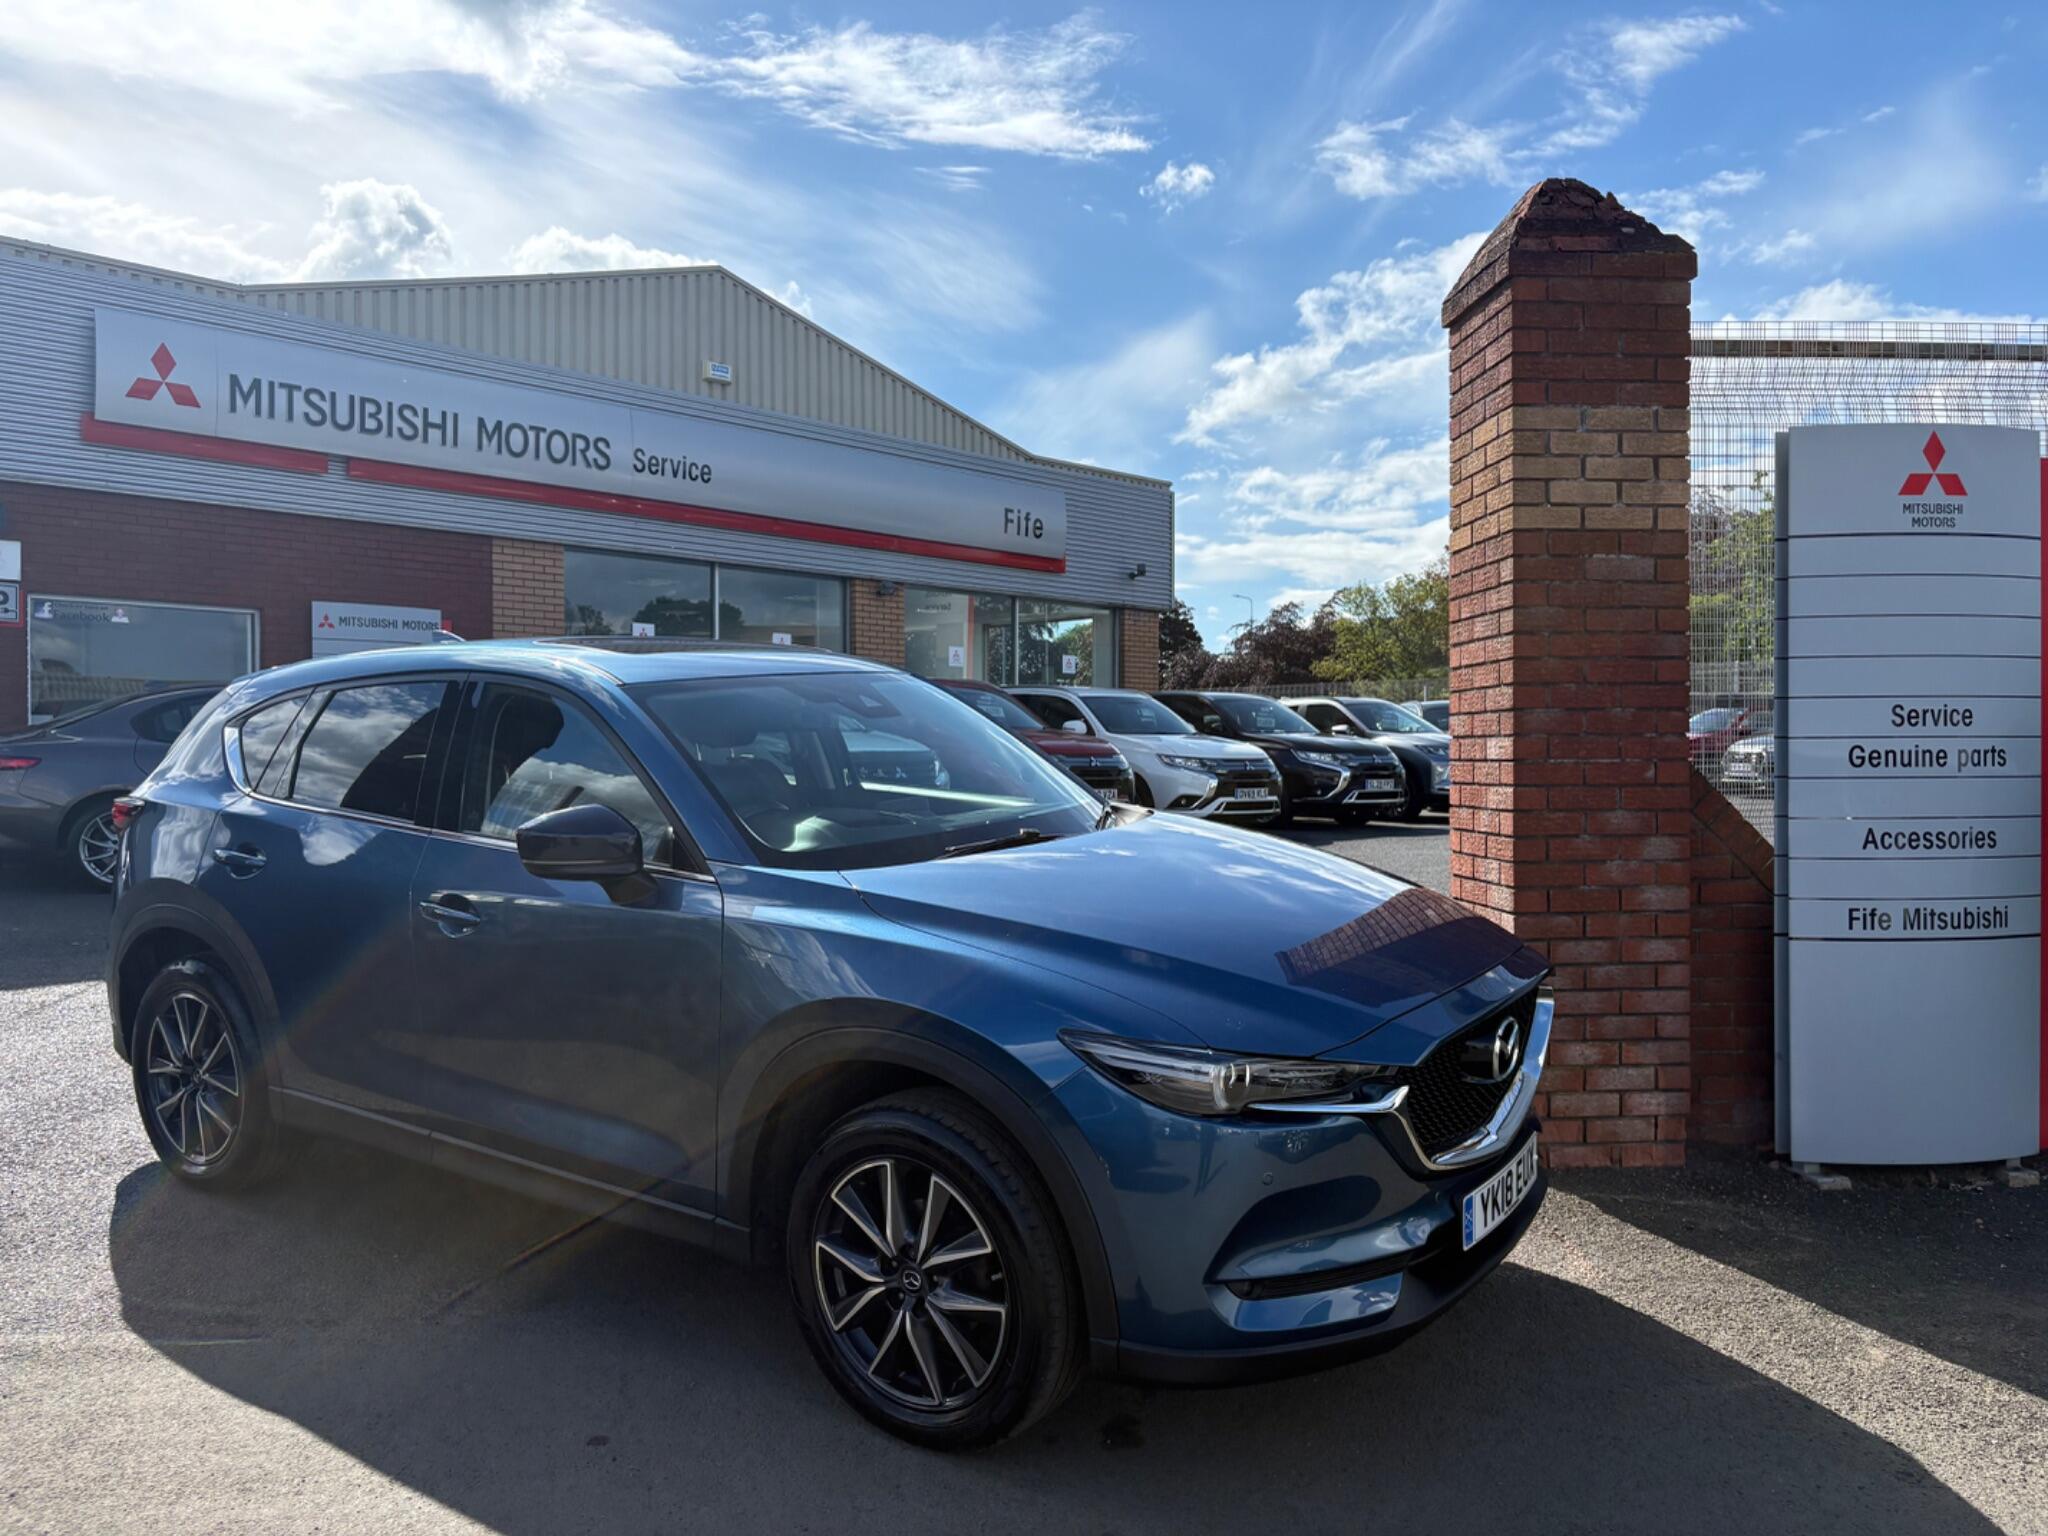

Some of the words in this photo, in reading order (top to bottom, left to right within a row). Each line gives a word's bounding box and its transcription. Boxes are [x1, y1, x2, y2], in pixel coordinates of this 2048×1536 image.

[229, 373, 459, 448] MITSUBISHI
[476, 416, 612, 471] MOTORS
[633, 448, 712, 484] Service
[1004, 507, 1044, 539] Fife
[1902, 503, 1963, 515] MITSUBISHI
[1911, 516, 1956, 528] MOTORS
[338, 616, 398, 630] MITSUBISHI
[402, 620, 439, 632] MOTORS
[1891, 704, 1974, 728] Service
[1848, 745, 1948, 769] Genuine
[1957, 746, 2008, 773] parts
[1862, 826, 1998, 850] Accessories
[1848, 907, 1892, 932] Fife
[1903, 905, 2009, 931] Mitsubishi
[1481, 1169, 1514, 1228] YK18
